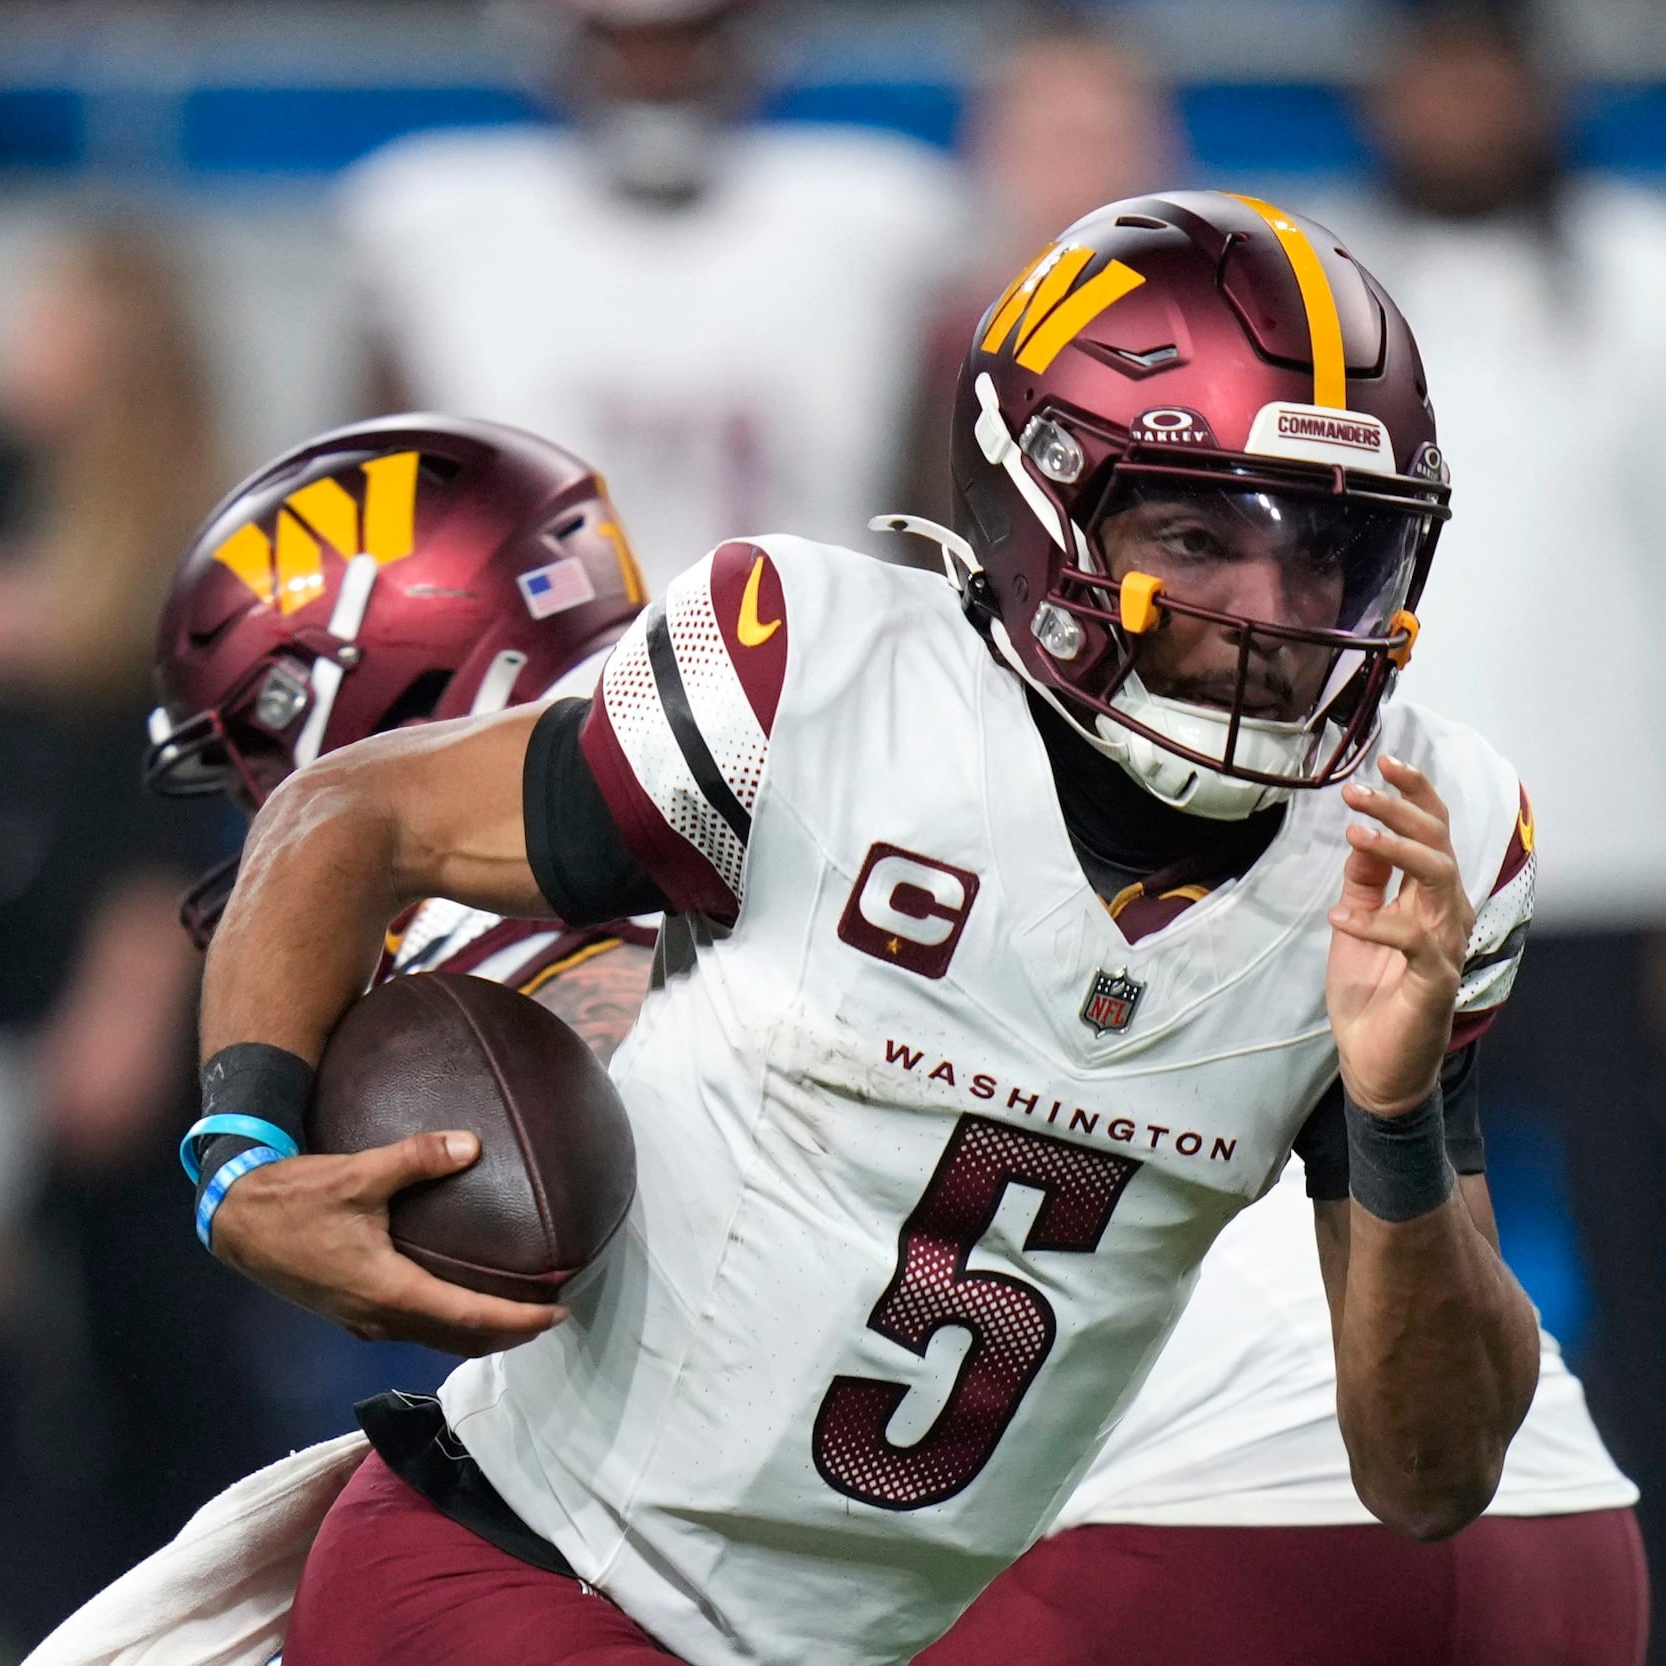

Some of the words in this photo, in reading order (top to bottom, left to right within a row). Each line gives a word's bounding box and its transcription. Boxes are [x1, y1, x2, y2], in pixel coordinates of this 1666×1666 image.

[1277, 415, 1381, 447] COMMANDERS
[858, 855, 966, 946] C
[1087, 994, 1130, 1026] NFL
[884, 1039, 1237, 1161] WASHINGTON
[811, 1110, 1145, 1512] 5
